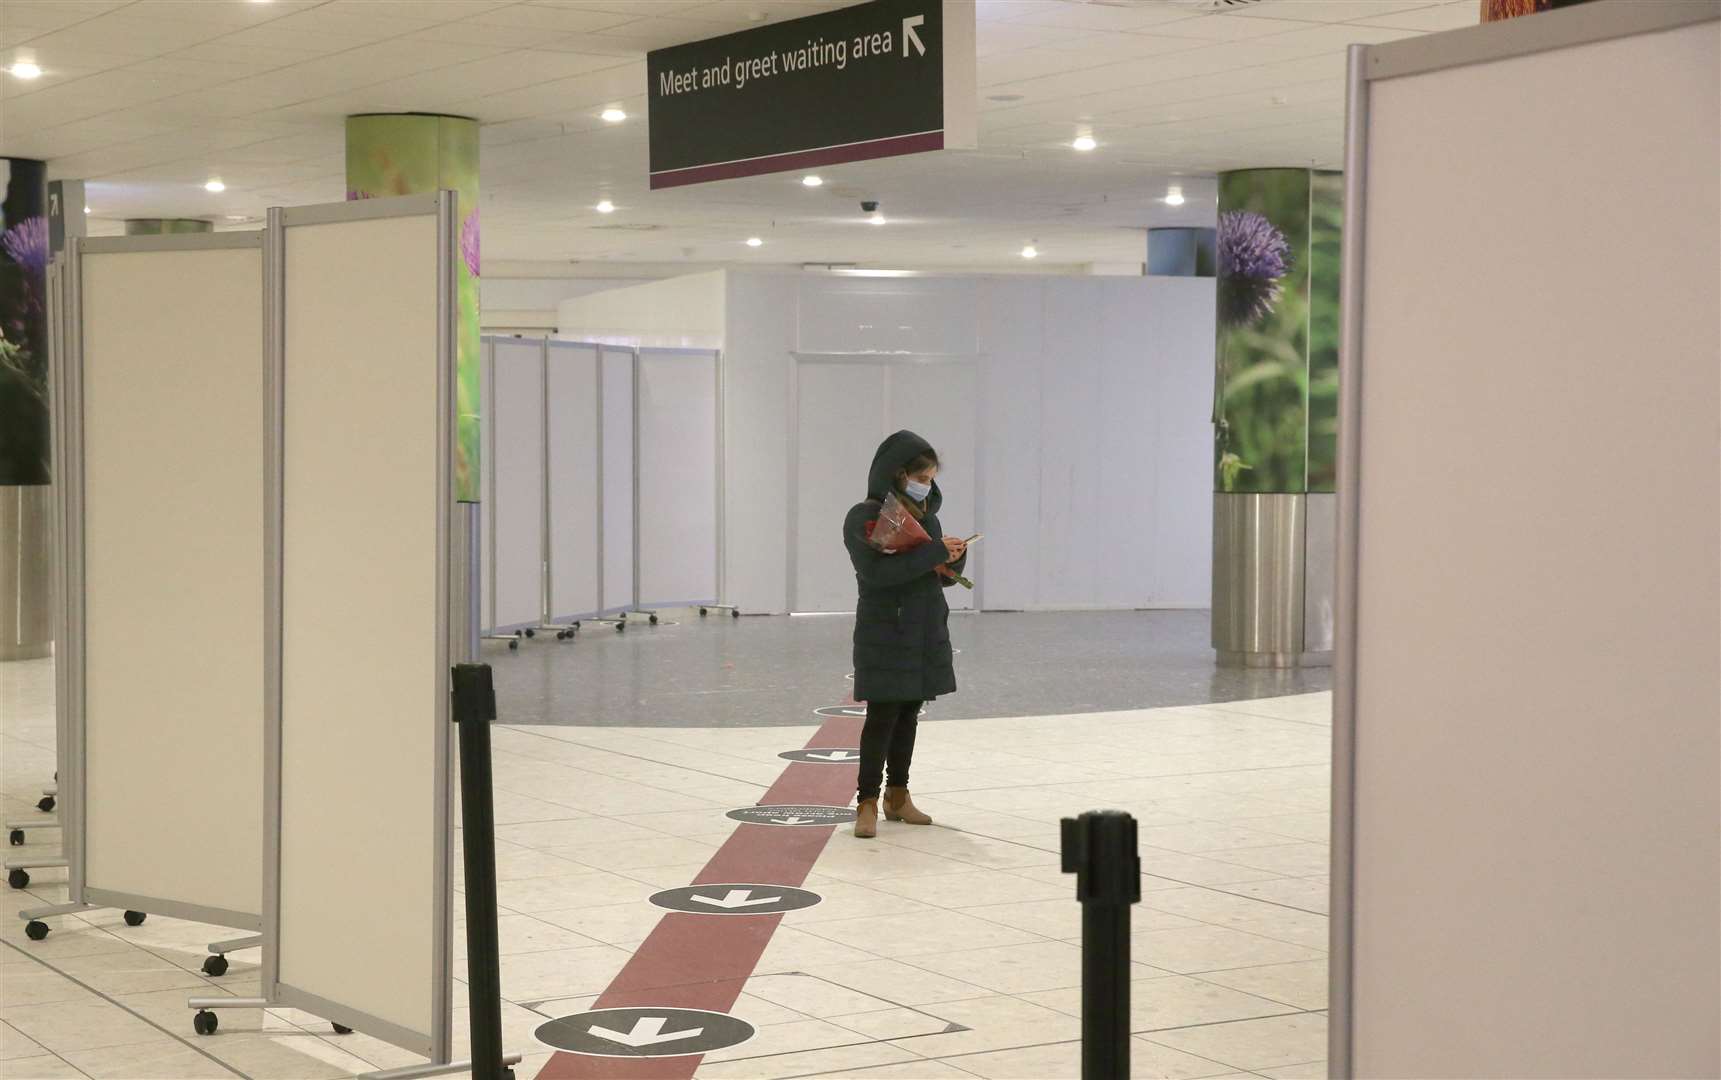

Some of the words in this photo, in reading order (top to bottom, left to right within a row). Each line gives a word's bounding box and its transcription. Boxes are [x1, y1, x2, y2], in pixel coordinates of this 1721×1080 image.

[660, 69, 698, 97] Meet
[702, 56, 731, 89] and
[735, 51, 778, 89] greet
[783, 37, 847, 73] waiting
[854, 31, 892, 59] area
